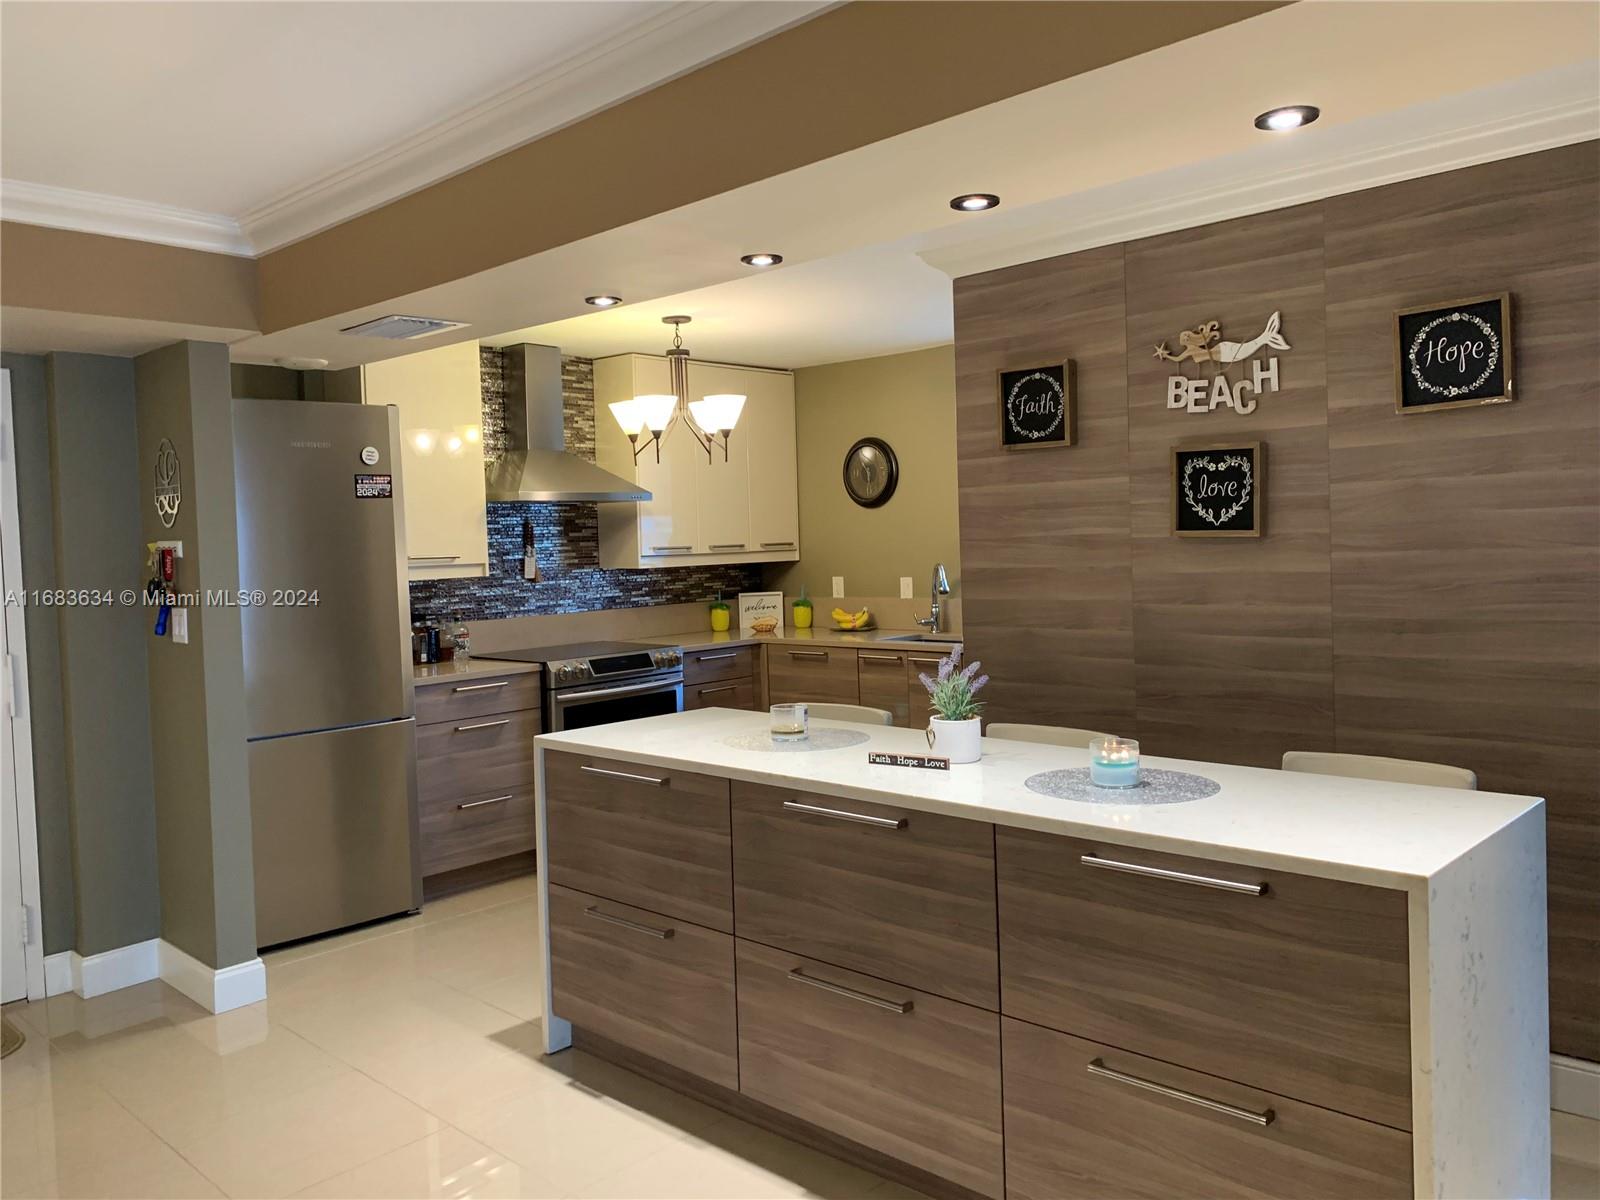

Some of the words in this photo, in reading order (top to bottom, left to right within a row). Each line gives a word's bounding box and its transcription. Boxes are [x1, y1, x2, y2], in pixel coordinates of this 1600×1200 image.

[1423, 337, 1484, 373] Hope
[1167, 357, 1279, 415] BEACH
[1015, 391, 1056, 421] Faith
[356, 475, 391, 484] TRUMP
[356, 488, 378, 496] 2024
[1197, 474, 1237, 499] love
[869, 753, 891, 764] Faith
[897, 755, 919, 767] Hope
[924, 757, 945, 768] Love
